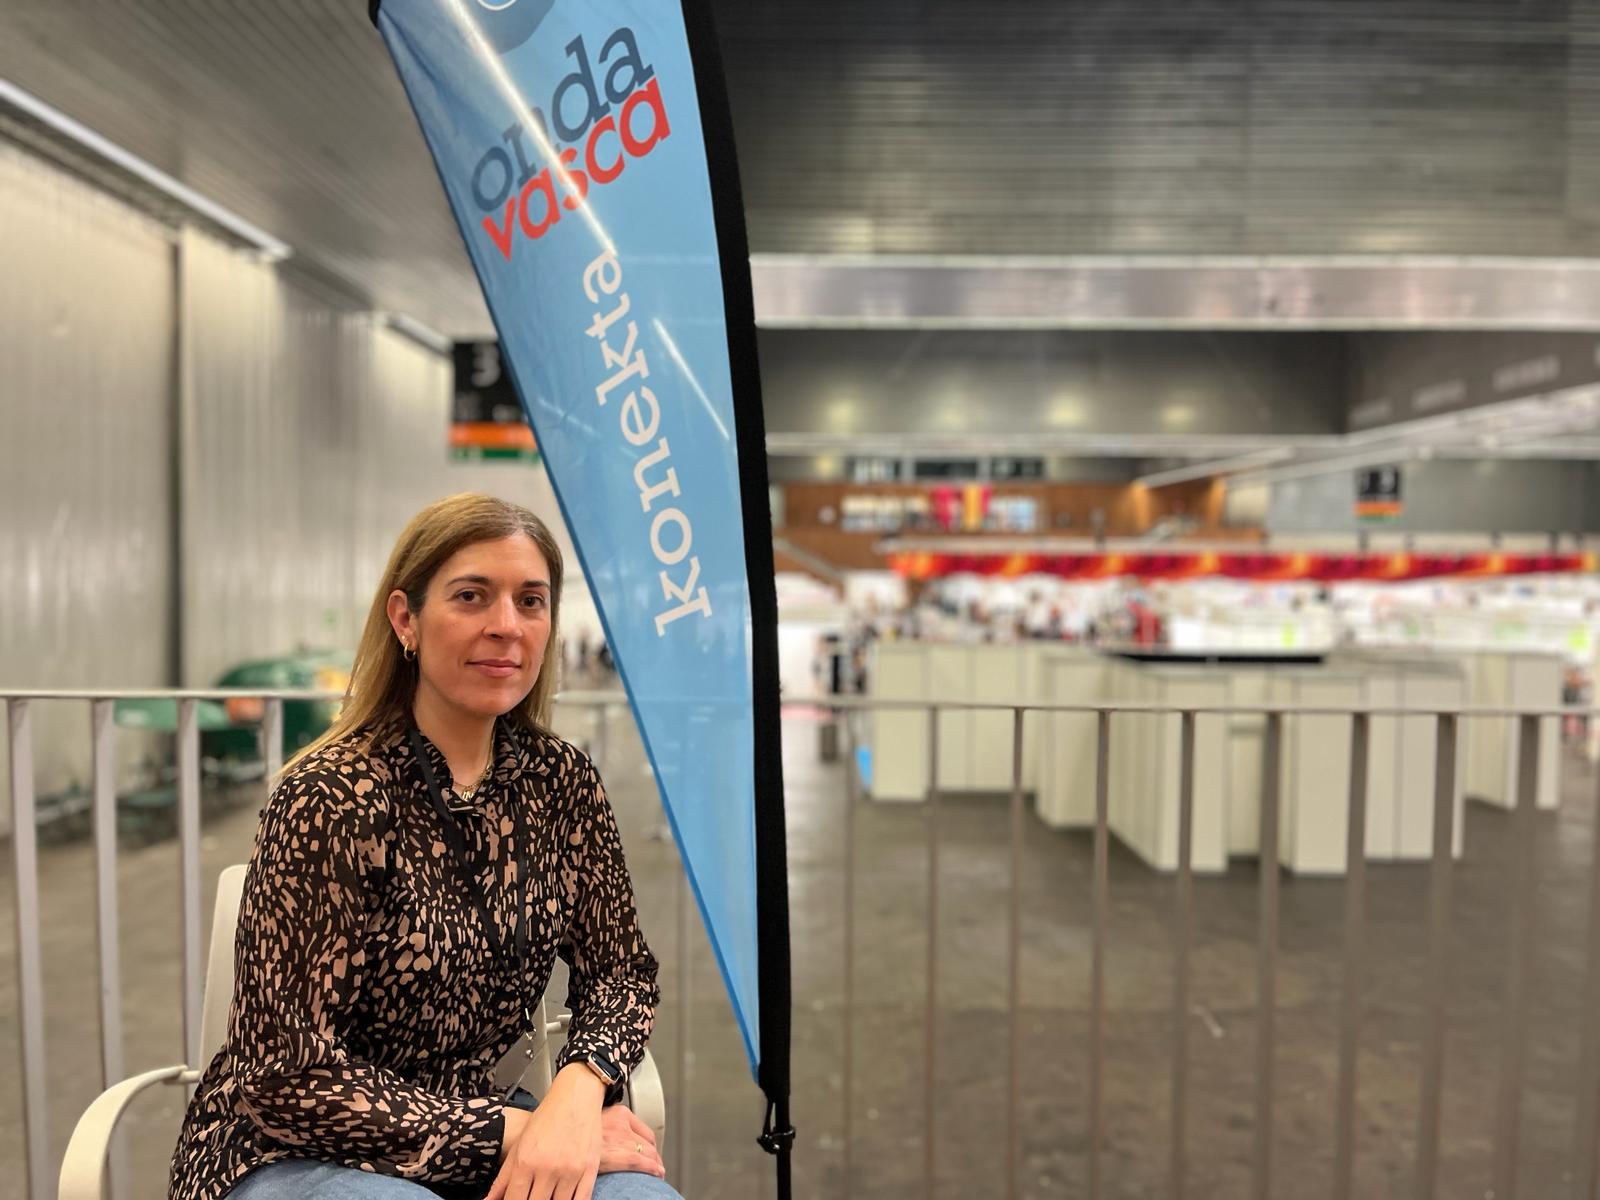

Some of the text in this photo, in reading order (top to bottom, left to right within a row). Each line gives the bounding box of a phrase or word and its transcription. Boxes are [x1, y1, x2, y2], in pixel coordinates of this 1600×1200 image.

[471, 27, 654, 212] onda
[481, 77, 671, 263] vasca
[583, 249, 712, 637] konekta
